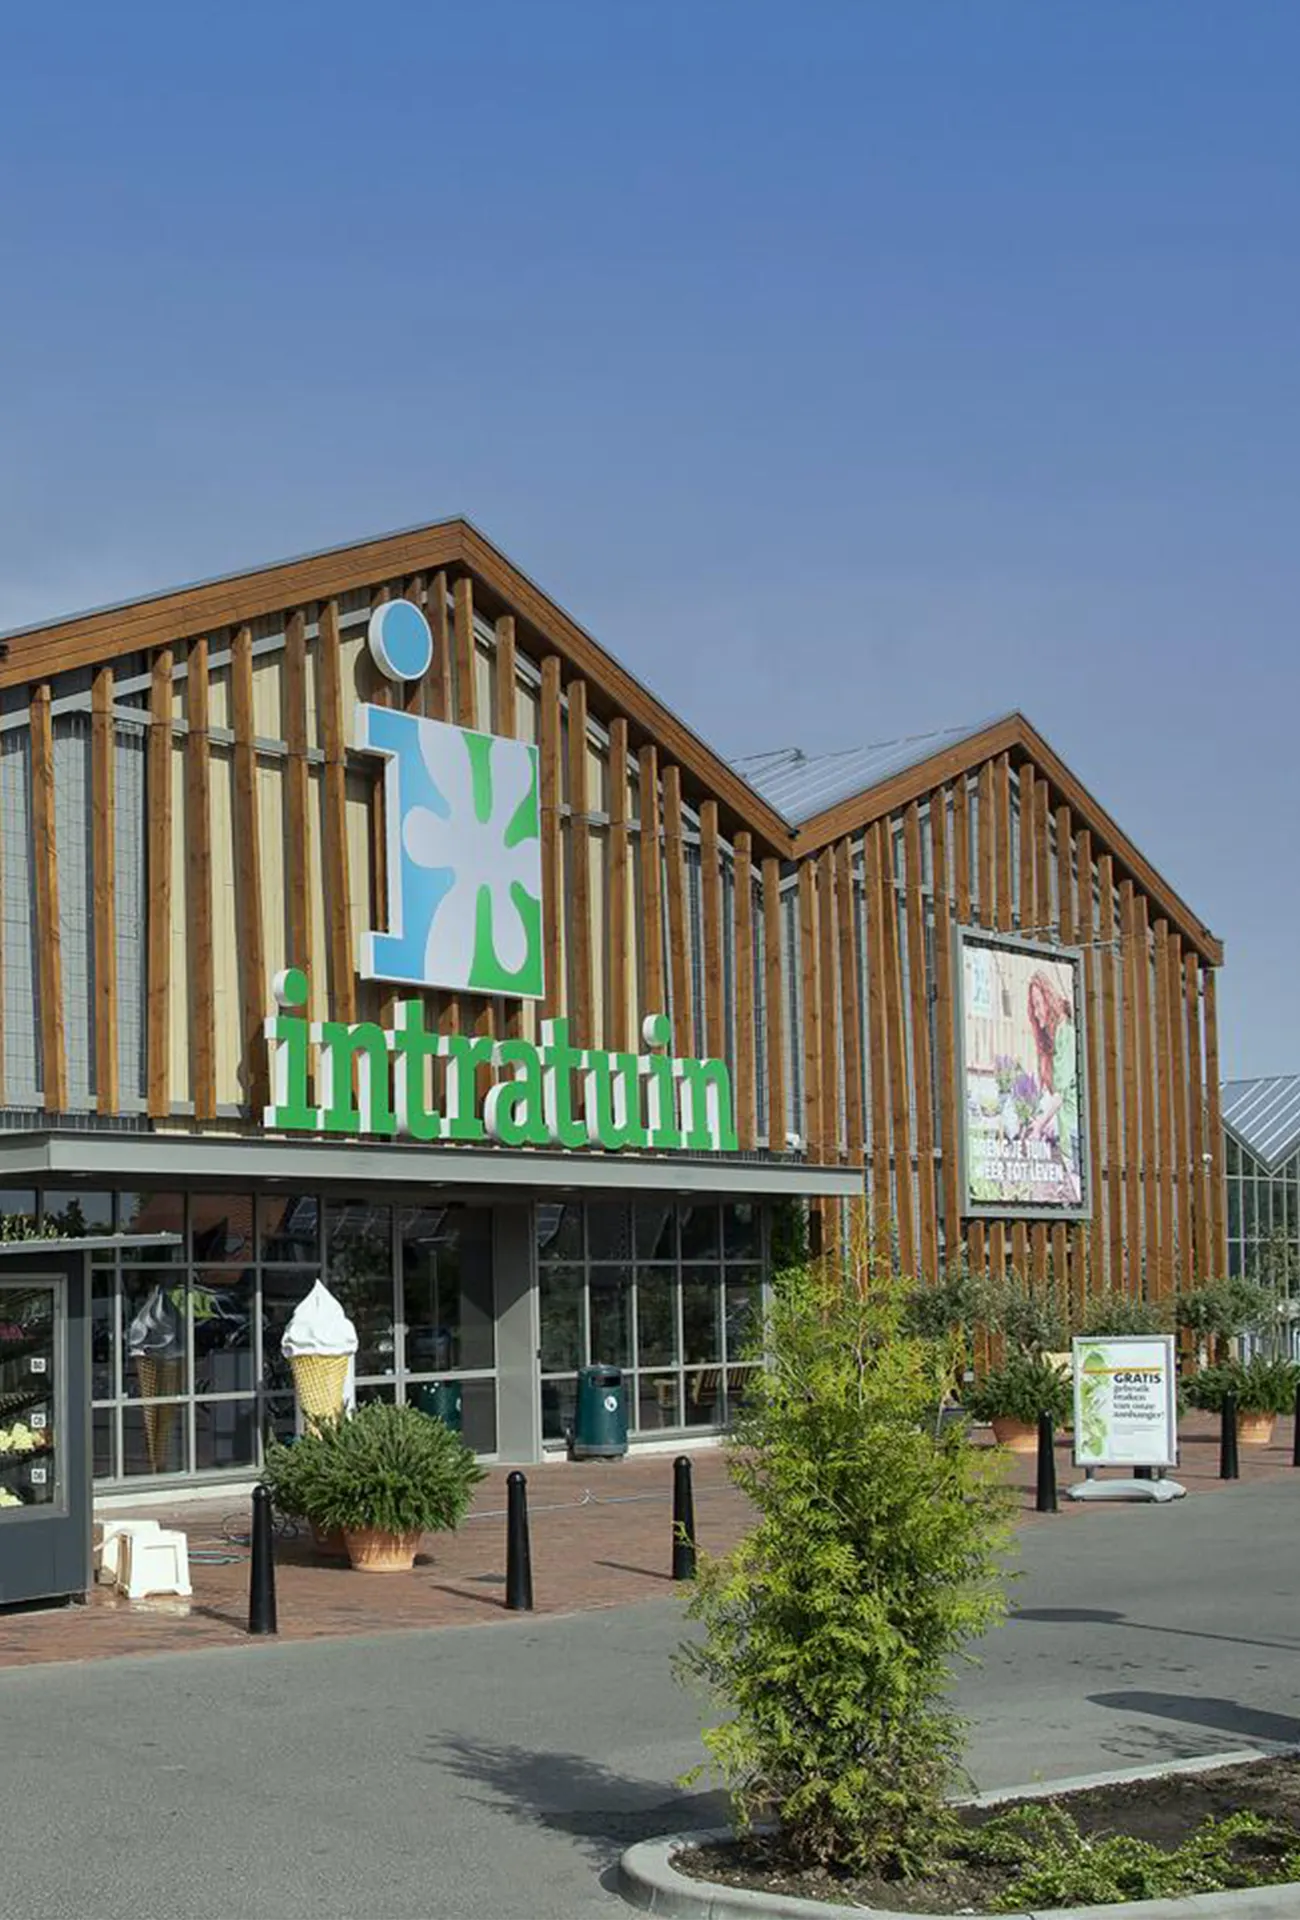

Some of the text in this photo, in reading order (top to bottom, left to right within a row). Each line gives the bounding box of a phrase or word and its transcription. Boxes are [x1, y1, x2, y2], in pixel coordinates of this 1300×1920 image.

[264, 968, 738, 1151] intratuin
[1032, 1162, 1064, 1182] LEVEN
[1113, 1372, 1161, 1384] GRATIS
